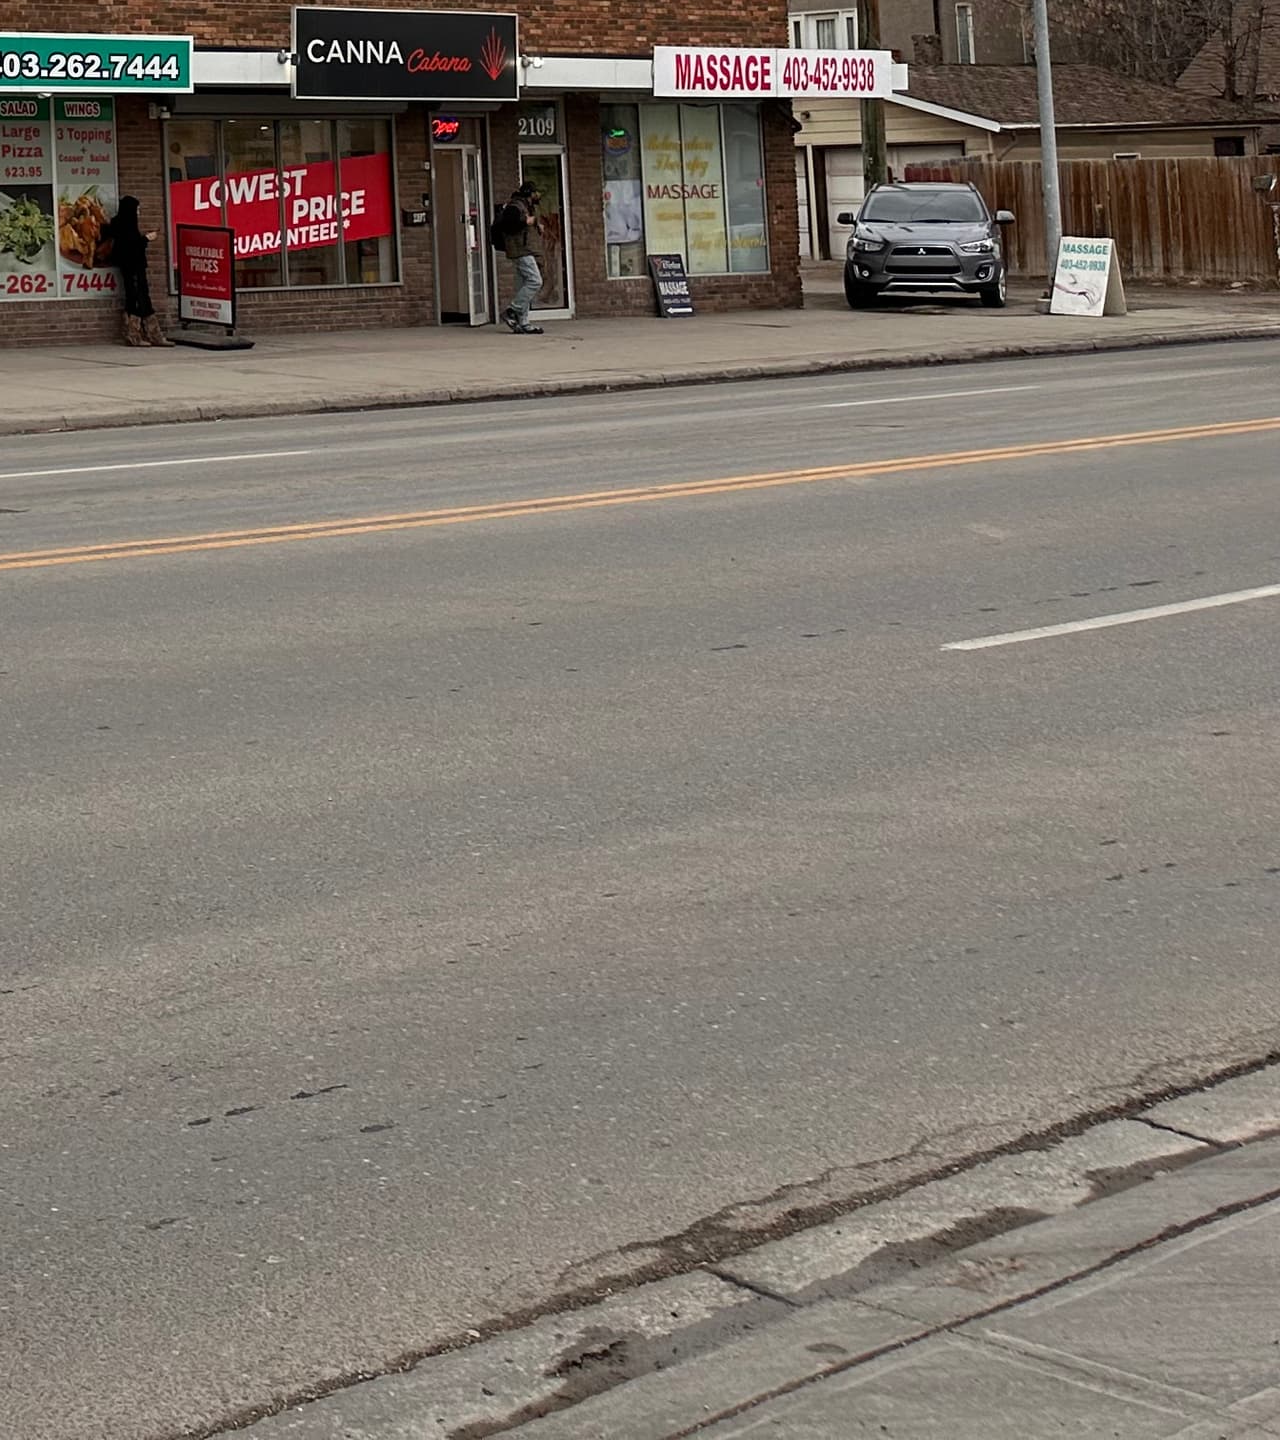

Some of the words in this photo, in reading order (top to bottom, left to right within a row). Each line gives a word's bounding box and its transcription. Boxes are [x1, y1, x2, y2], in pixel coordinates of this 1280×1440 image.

[307, 39, 404, 65] CANNA
[407, 48, 472, 73] Cabana
[674, 53, 772, 91] MASSAGE
[782, 56, 875, 92] 403-452-9938
[0, 101, 37, 115] SALAD
[65, 102, 100, 116] WINGS
[2, 125, 41, 141] Large
[518, 118, 555, 136] 2109
[57, 127, 64, 140] 3
[67, 128, 113, 144] Topping
[1, 144, 43, 158] Pizza
[5, 166, 42, 178] $23.95
[194, 168, 308, 211] LOWEST
[647, 184, 721, 200] MASSAGE
[292, 189, 366, 225] PRICE
[185, 245, 225, 260] UNBEATABLE
[1063, 243, 1109, 256] MASSAGE
[190, 258, 220, 274] PRICES
[63, 273, 118, 293] 7444
[658, 281, 689, 296] MASSAGE
